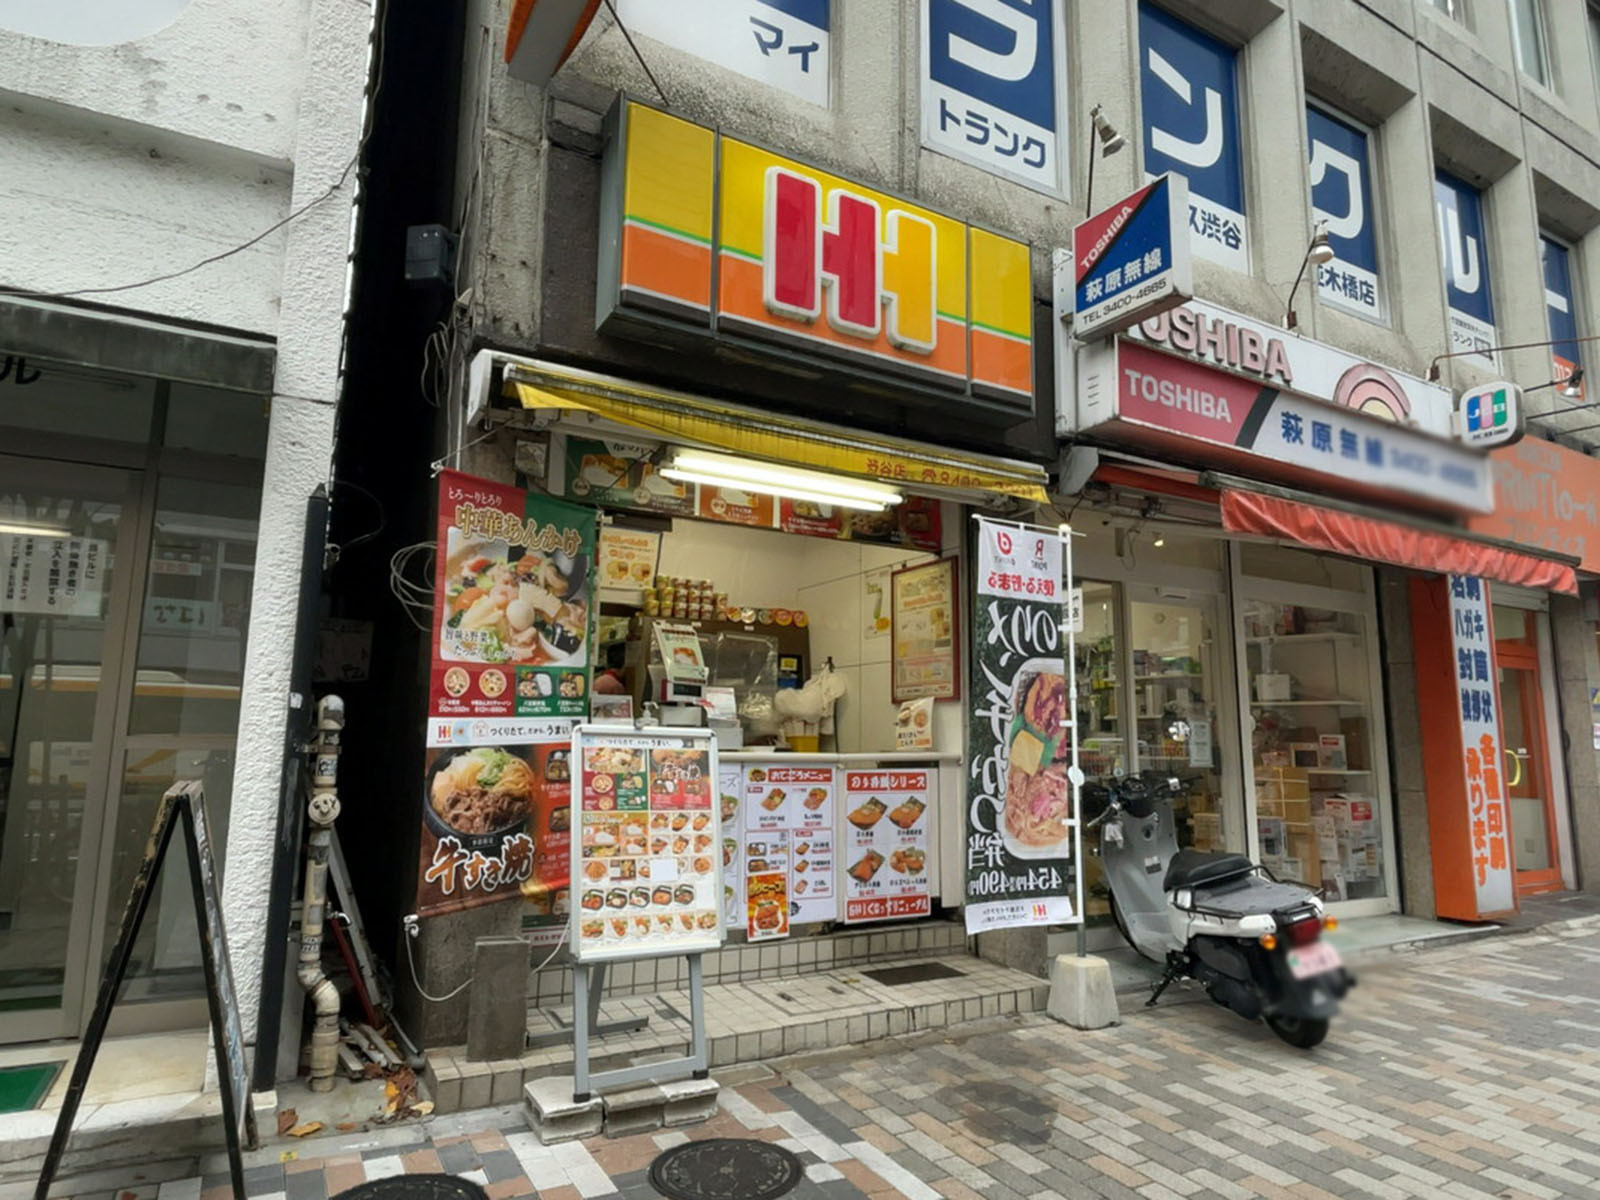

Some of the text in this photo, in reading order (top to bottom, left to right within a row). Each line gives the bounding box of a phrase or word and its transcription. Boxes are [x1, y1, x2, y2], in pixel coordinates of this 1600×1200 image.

[750, 16, 819, 72] マイ
[940, 98, 1046, 169] トランク
[1080, 205, 1133, 269] TOSHIBA
[1083, 312, 1102, 325] TEL
[1139, 306, 1293, 386] OSHIBA
[1125, 368, 1233, 424] TOSHIBA
[455, 502, 582, 559] 中華あんかけ
[1454, 608, 1484, 642] ハガキ
[1458, 646, 1489, 682] 封筒
